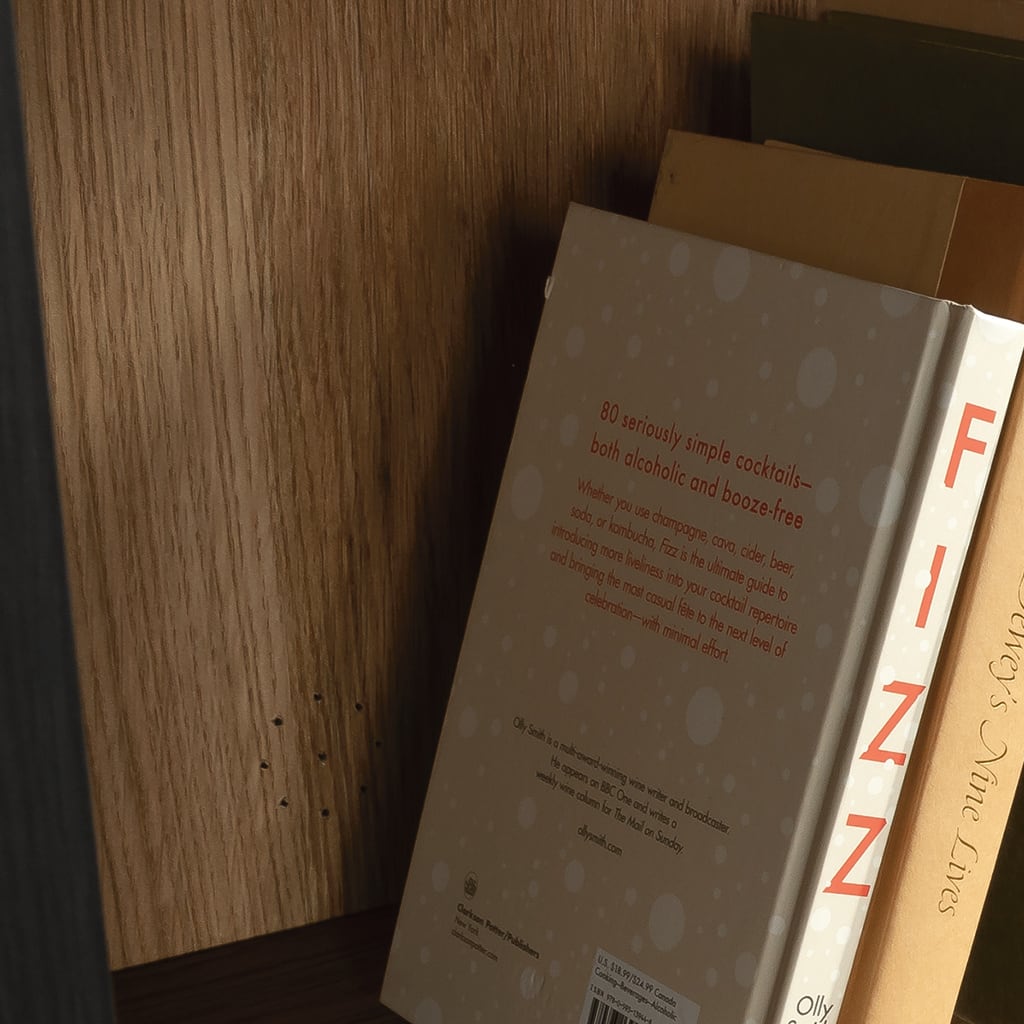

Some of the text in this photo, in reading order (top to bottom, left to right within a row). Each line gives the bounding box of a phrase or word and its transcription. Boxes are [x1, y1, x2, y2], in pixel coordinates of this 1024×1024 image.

[600, 400, 619, 424] 80
[622, 416, 682, 451] seriously
[686, 433, 731, 464] simple
[591, 432, 804, 529] both alcoholic and booze-free
[570, 504, 788, 601] soda, or kombucha, Fizz is the ultimate guide to
[577, 476, 794, 578] Whether you use champagne, cava, cider, beer,
[550, 549, 788, 658] and bringing the most casual fête to the next level of
[551, 520, 798, 634] introducing more liveliness into your cocktail repertoire
[663, 625, 701, 650] minimal
[701, 639, 728, 663] effort.
[527, 724, 545, 741] Smith
[629, 777, 645, 791] wine
[647, 787, 667, 802] writer
[669, 798, 685, 811] and
[551, 755, 677, 829] He appears on BBC One and writes a
[962, 719, 1008, 822] Nine
[559, 782, 575, 797] wine
[576, 790, 600, 809] column
[601, 800, 611, 815] for
[614, 807, 626, 823] The
[627, 815, 645, 832] Mail
[644, 828, 654, 838] on
[656, 830, 684, 855] Sunday.
[938, 827, 979, 917] Lives
[654, 988, 677, 1008] Canada
[796, 995, 834, 1023] Olly
